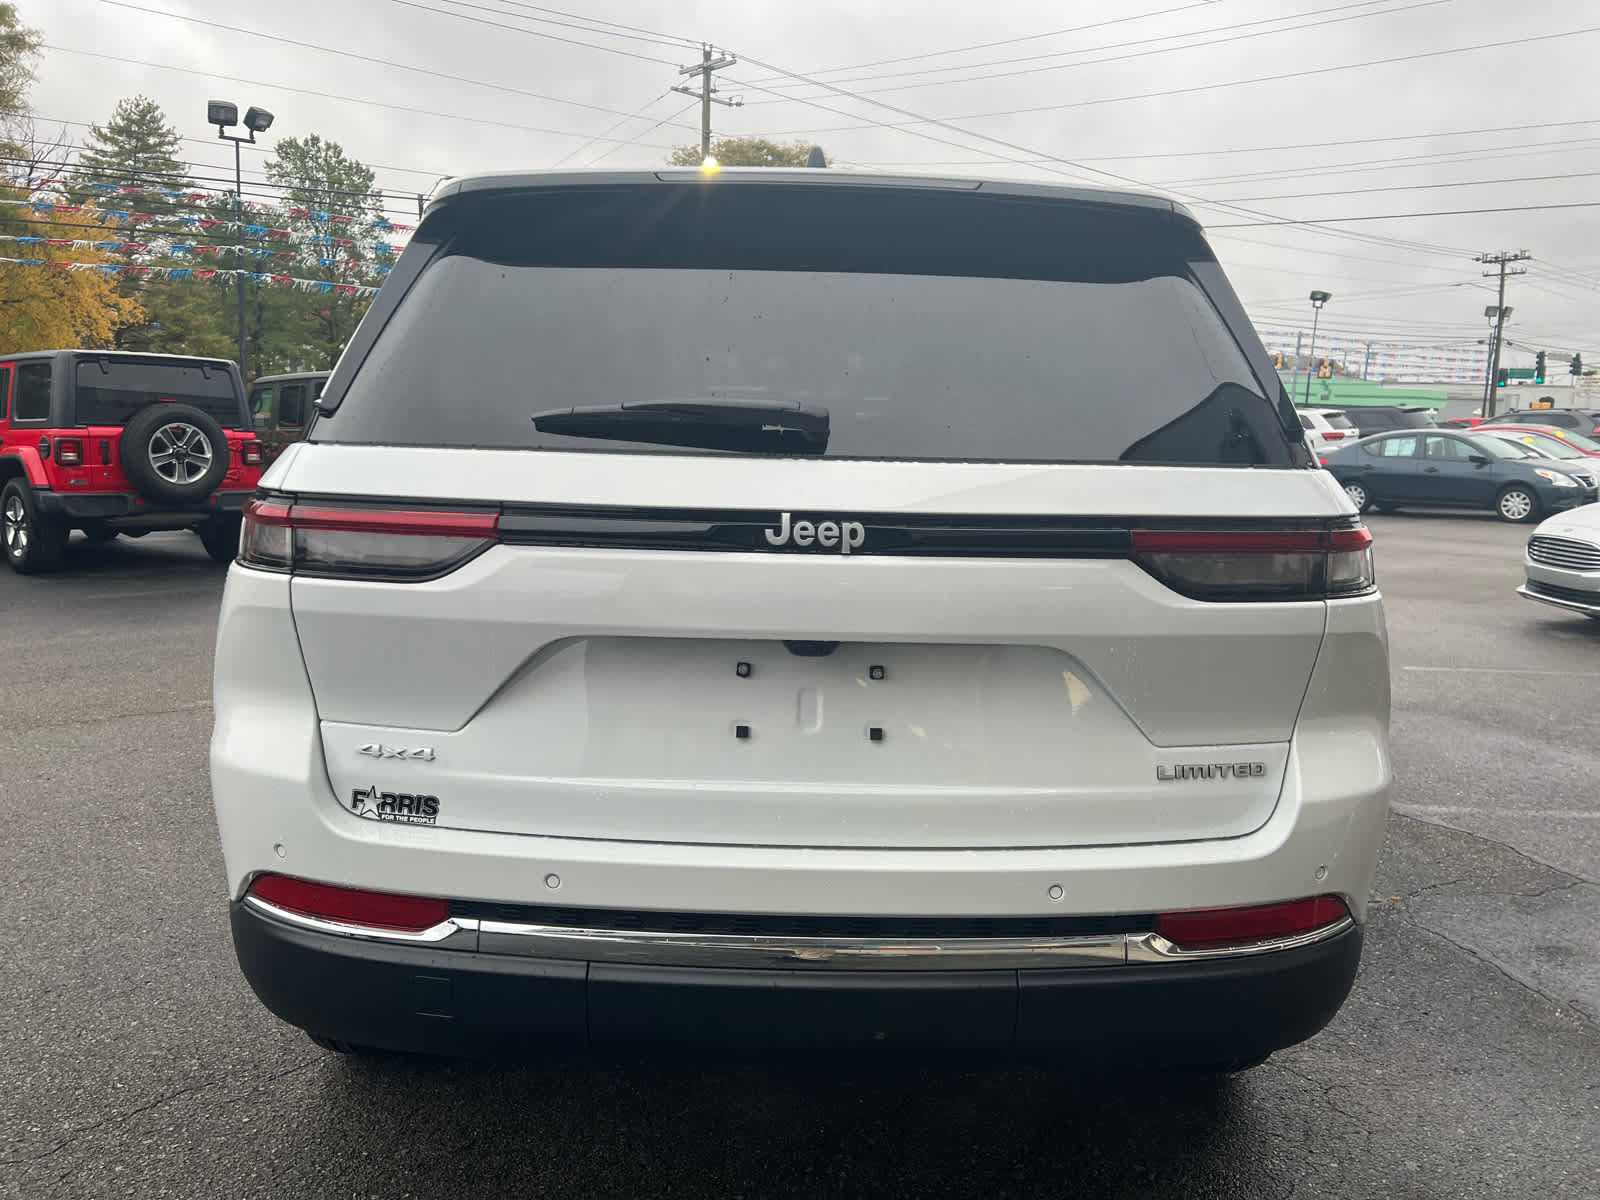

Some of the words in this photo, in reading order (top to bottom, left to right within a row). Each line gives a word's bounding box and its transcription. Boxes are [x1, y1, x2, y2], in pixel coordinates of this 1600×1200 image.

[765, 512, 865, 554] Jeep
[357, 743, 436, 761] 4x4
[1157, 761, 1265, 781] LIMITED
[409, 816, 434, 824] PEOPLE
